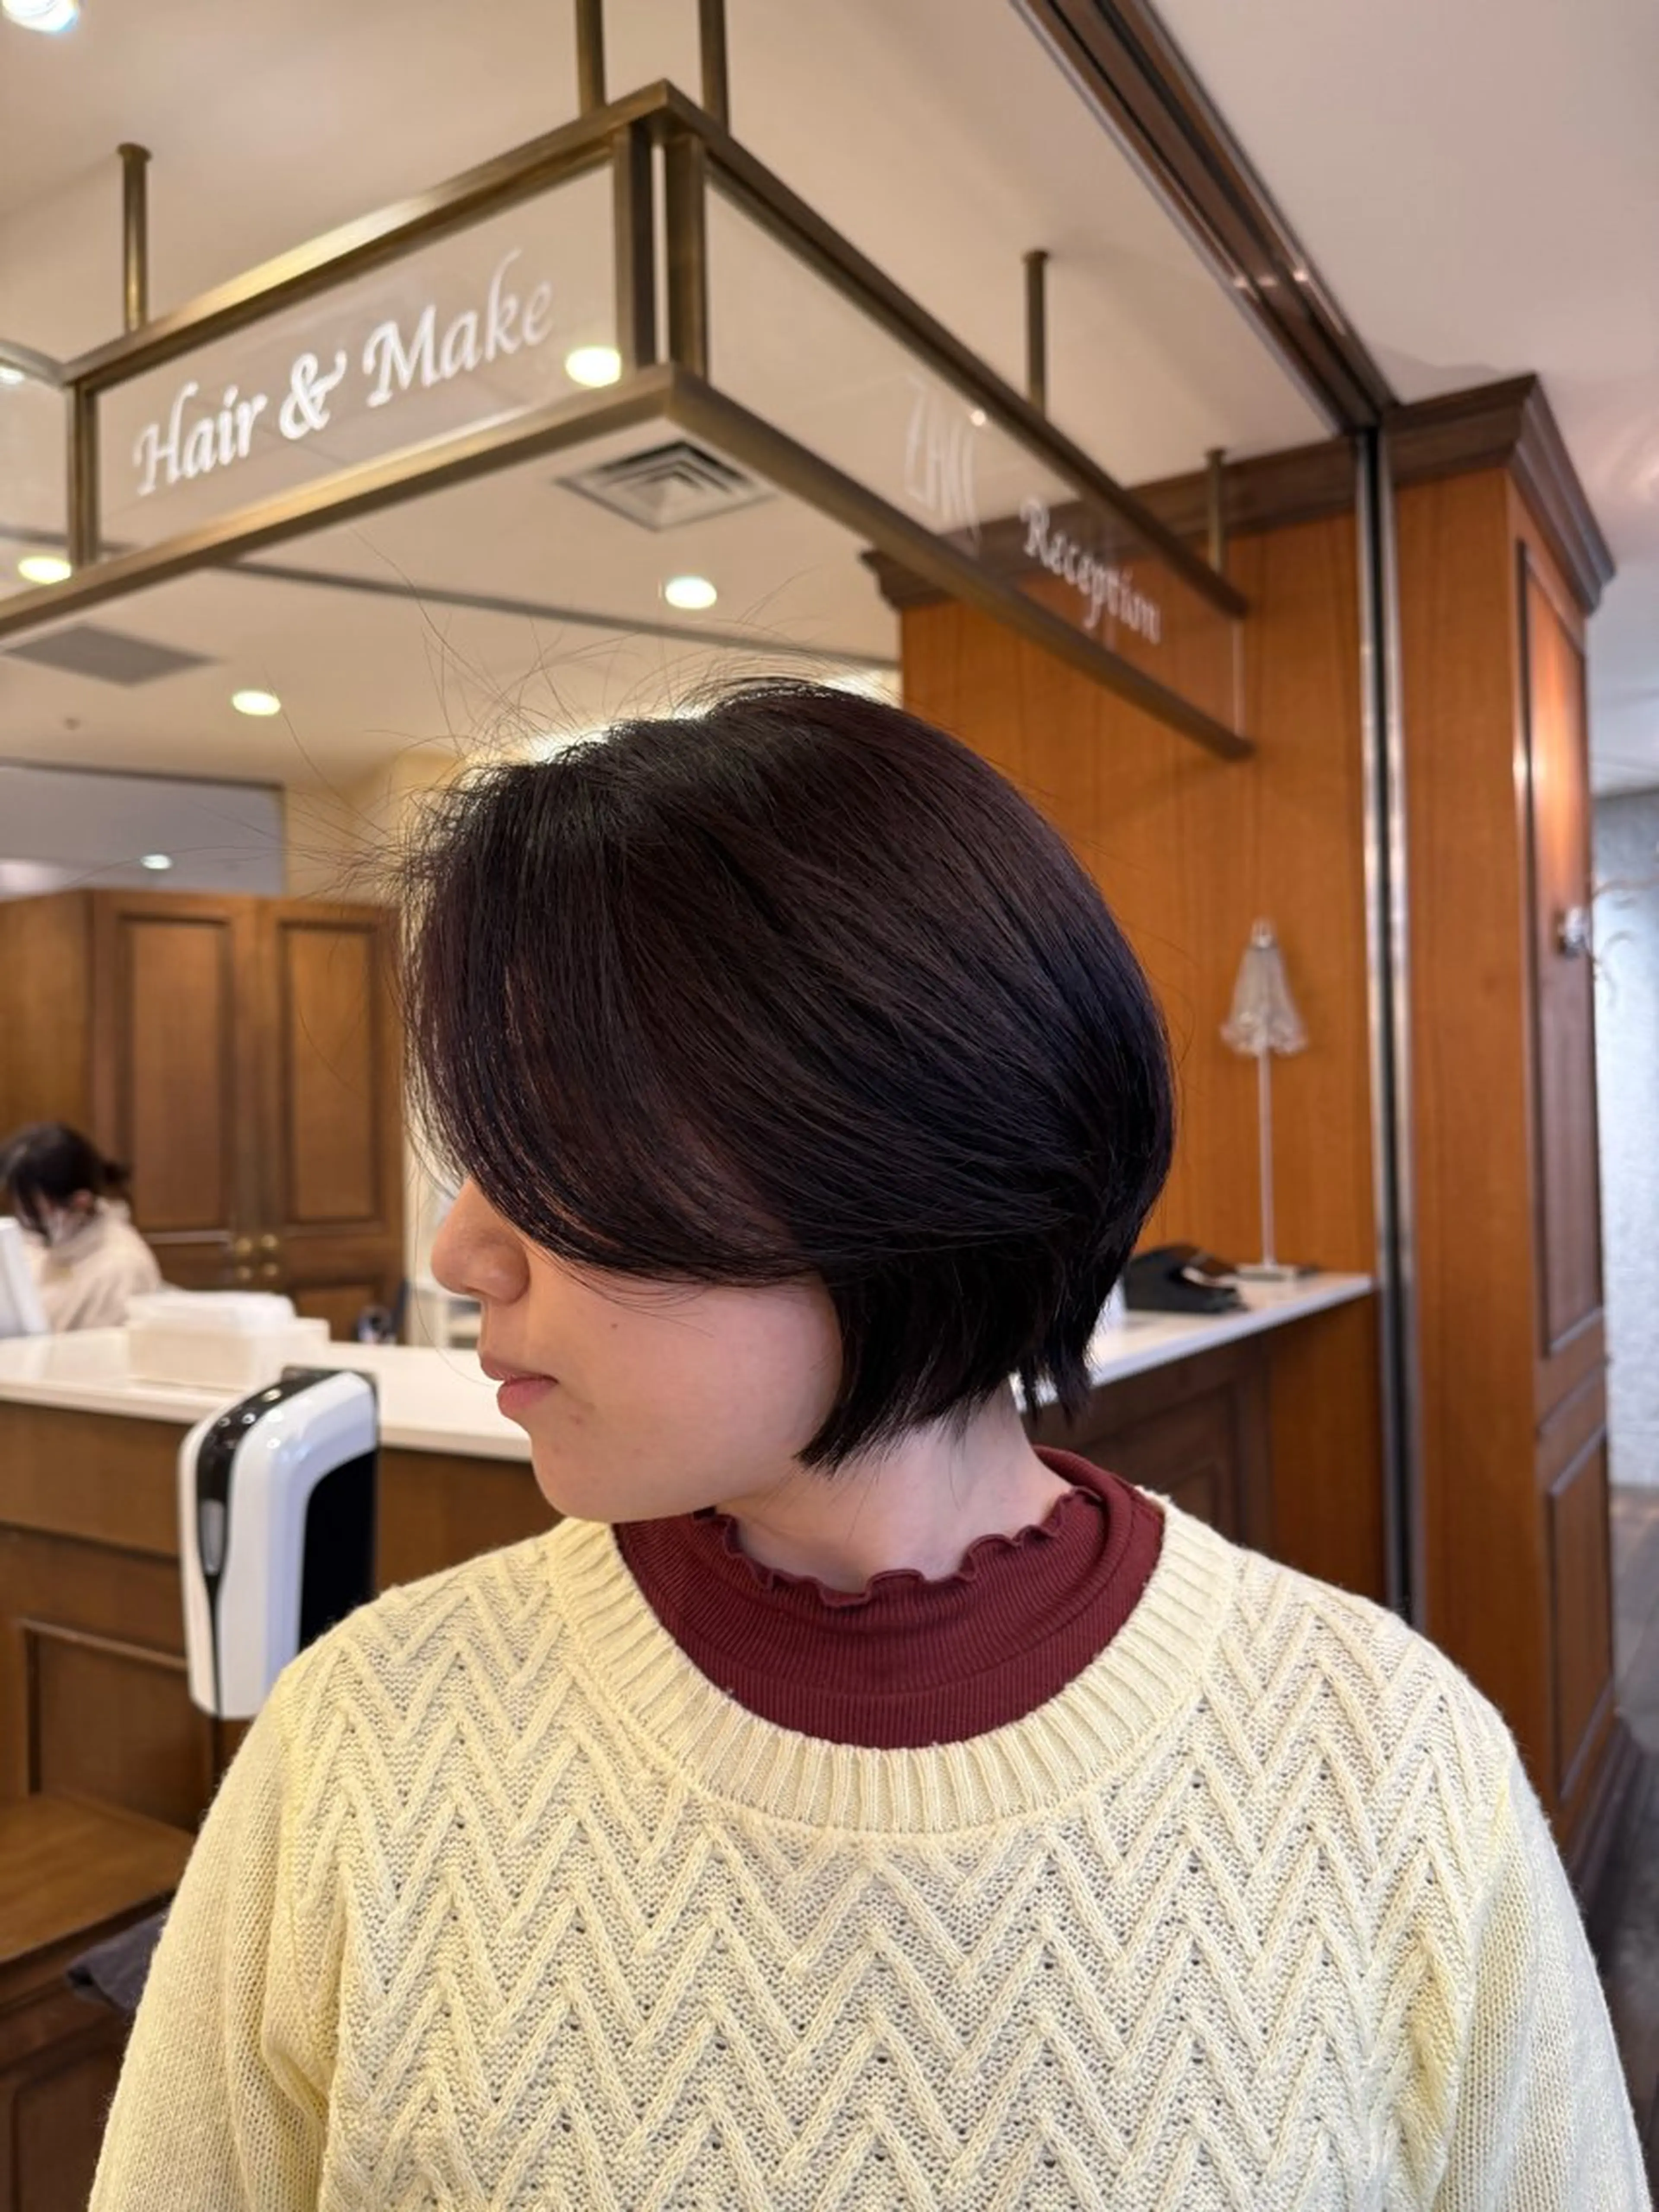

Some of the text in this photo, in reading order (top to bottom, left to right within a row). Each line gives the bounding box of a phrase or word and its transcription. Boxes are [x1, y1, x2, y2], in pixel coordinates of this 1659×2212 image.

[132, 248, 553, 496] Hair & Make
[1020, 498, 1160, 645] Reception
